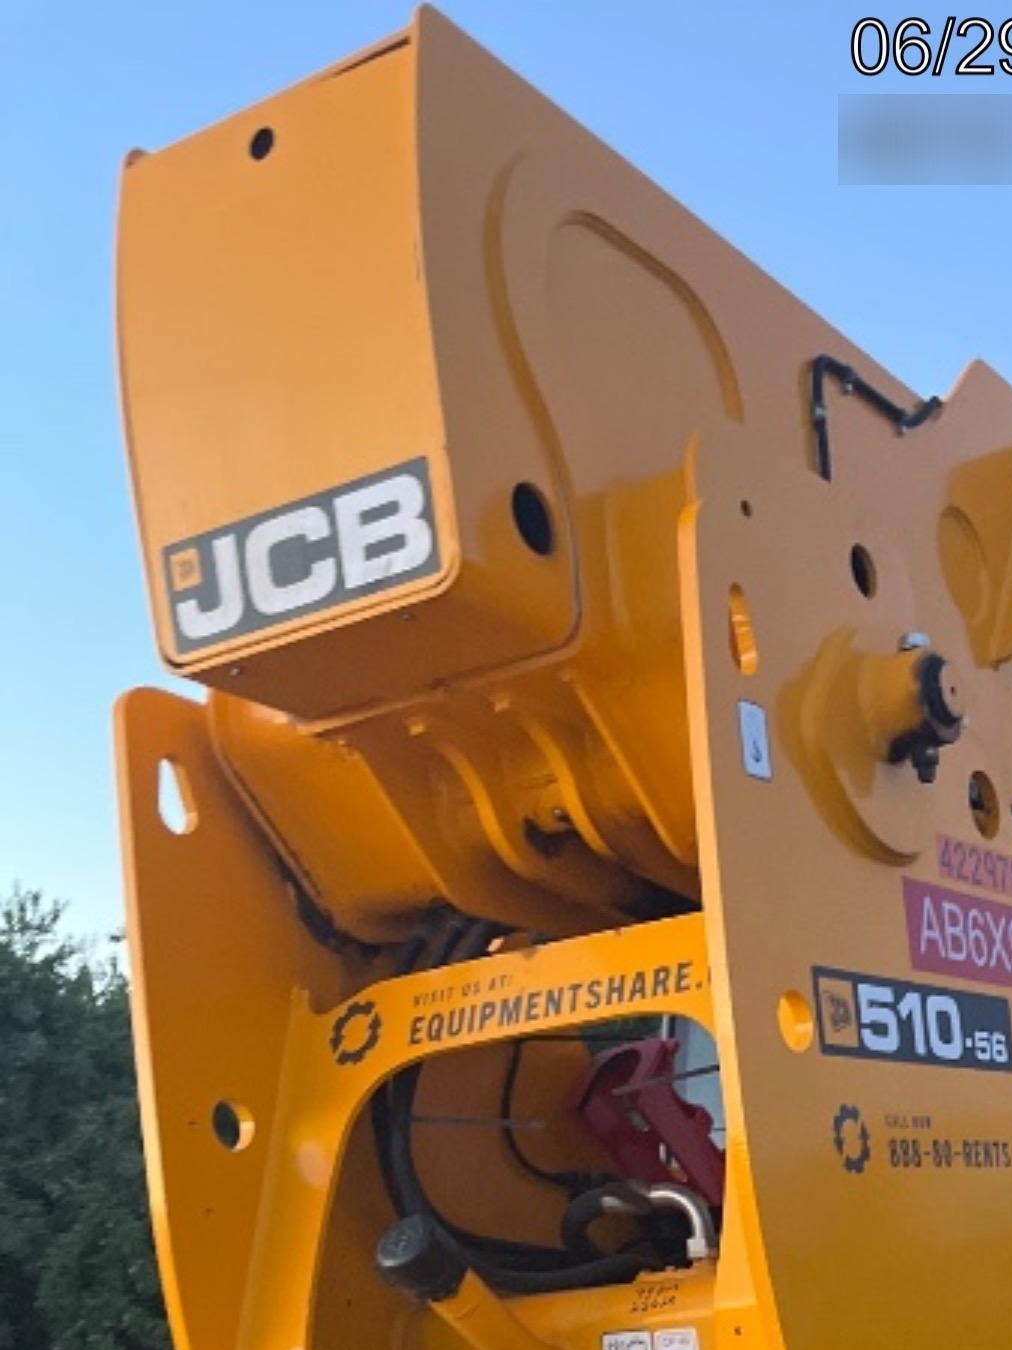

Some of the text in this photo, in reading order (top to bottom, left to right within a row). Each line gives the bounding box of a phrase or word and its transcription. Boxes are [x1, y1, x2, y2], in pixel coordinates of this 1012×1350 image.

[176, 473, 433, 640] JCB
[409, 960, 711, 1044] EQUIPMENTSHARE.
[461, 981, 481, 996] US
